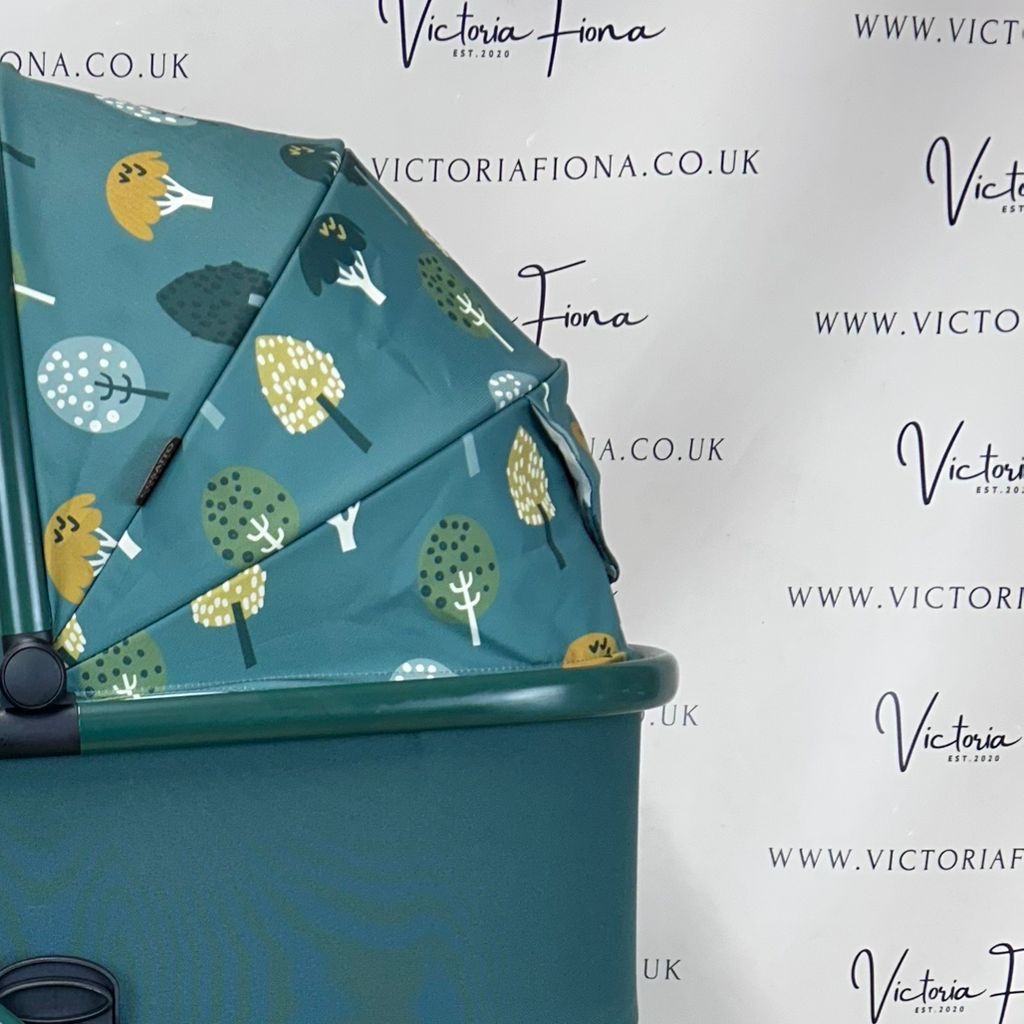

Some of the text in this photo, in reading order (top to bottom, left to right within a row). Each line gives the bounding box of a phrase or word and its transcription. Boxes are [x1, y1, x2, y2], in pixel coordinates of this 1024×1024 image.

[378, 0, 534, 69] Victoria
[452, 49, 510, 58] EST.2020
[855, 14, 1024, 45] WWW.VICT
[517, 260, 648, 347] Fiona
[875, 691, 1023, 772] Victoria
[947, 754, 1001, 763] EST.2020
[851, 948, 988, 1024] Victoria
[914, 1005, 965, 1014] EST.2020
